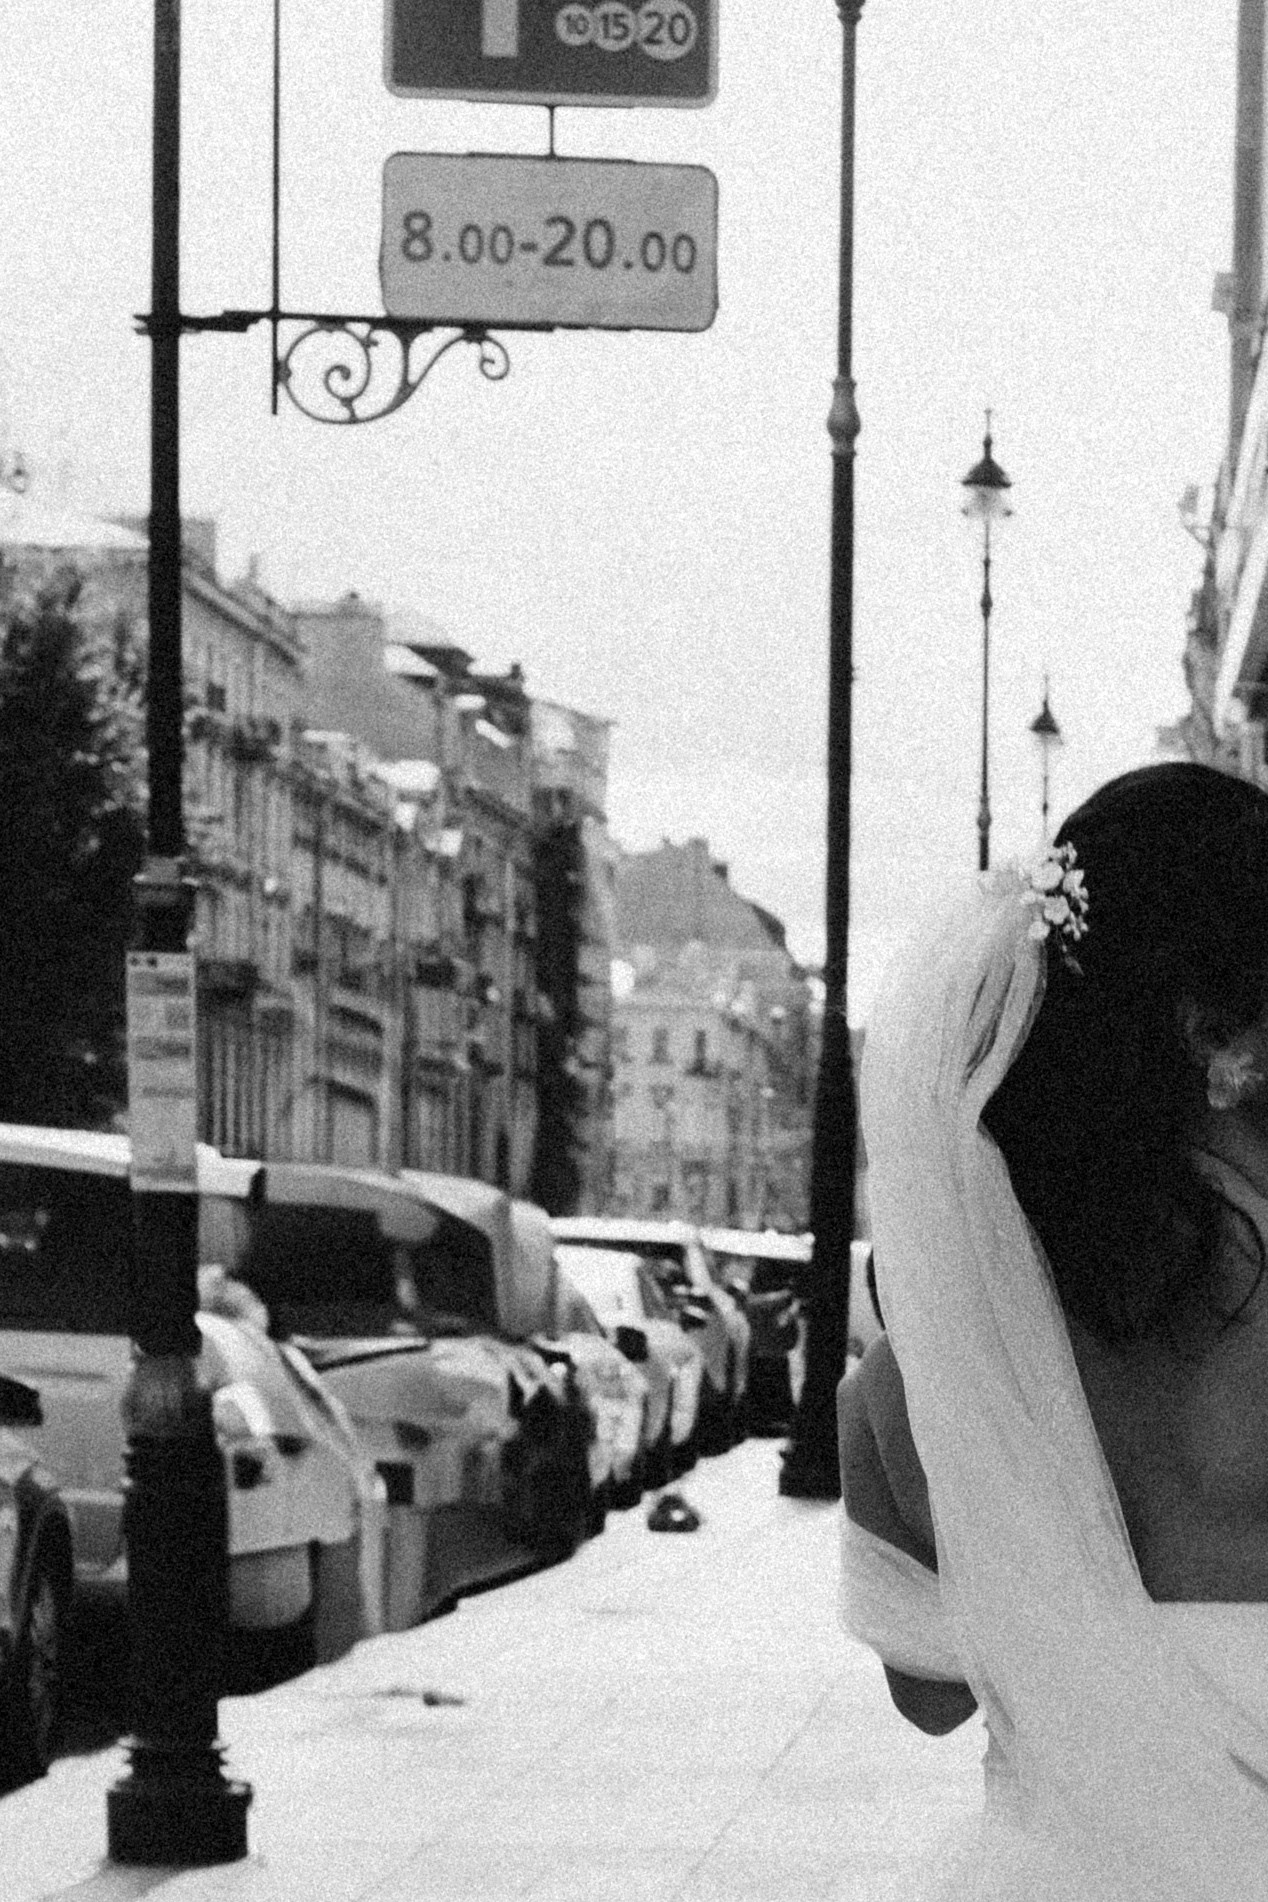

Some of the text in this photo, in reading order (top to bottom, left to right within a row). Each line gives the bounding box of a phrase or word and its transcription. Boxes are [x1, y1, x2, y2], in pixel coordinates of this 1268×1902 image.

[564, 11, 691, 46] 10 15 20
[402, 210, 697, 274] 8.00-20.00
